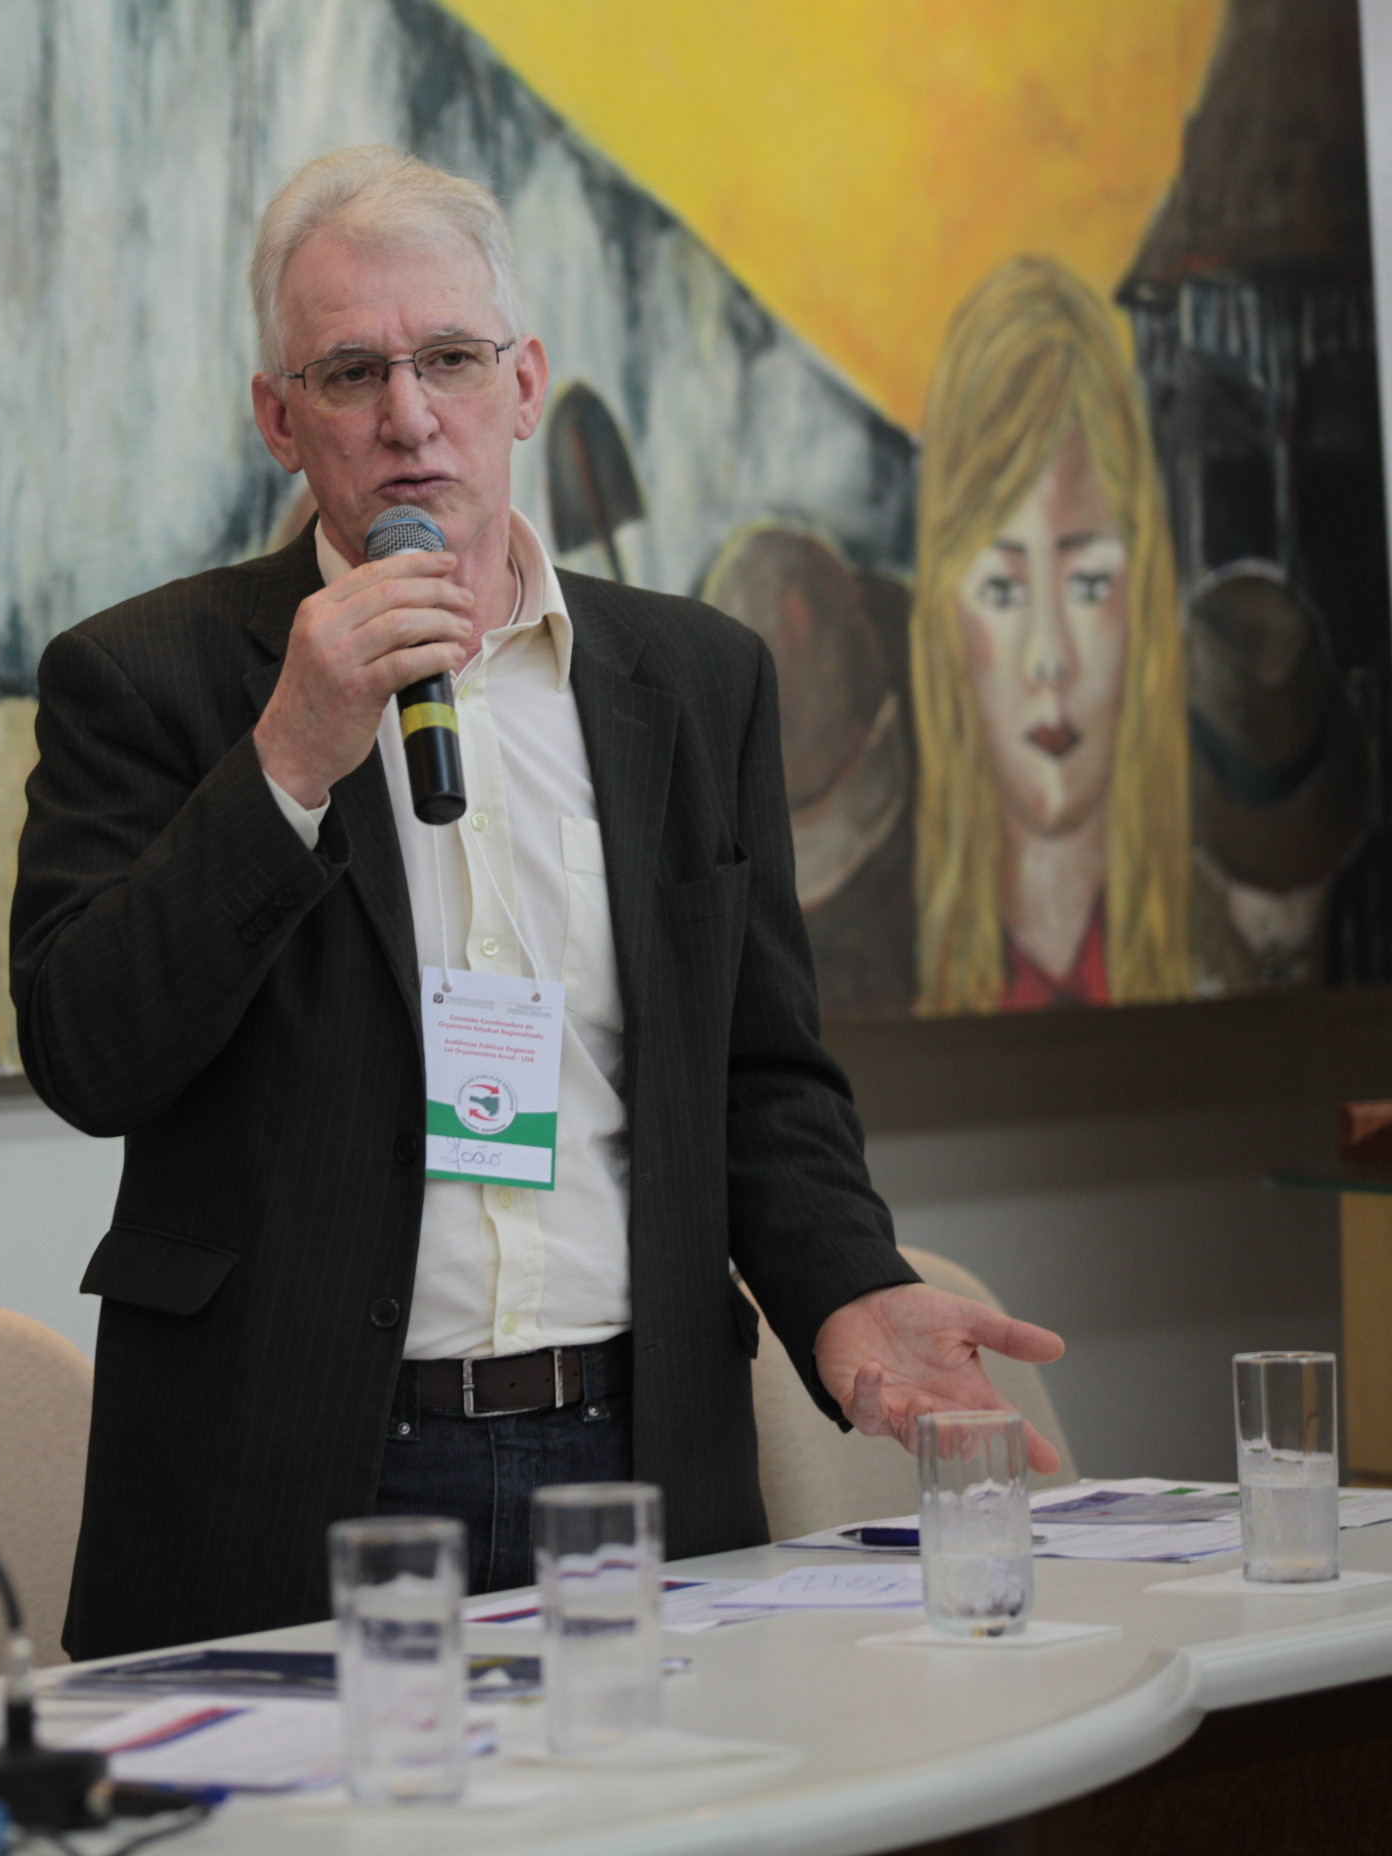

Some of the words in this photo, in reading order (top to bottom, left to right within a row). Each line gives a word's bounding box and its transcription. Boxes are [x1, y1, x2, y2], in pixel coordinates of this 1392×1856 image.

[449, 1014, 479, 1023] Comissão
[480, 1017, 523, 1029] Coordenadora
[438, 1021, 472, 1031] Orçamento
[473, 1025, 499, 1034] Estadual
[500, 1028, 544, 1040] Regionalizado
[479, 1041, 504, 1051] Públicas
[505, 1045, 536, 1055] Regionais
[497, 1053, 516, 1061] Anual
